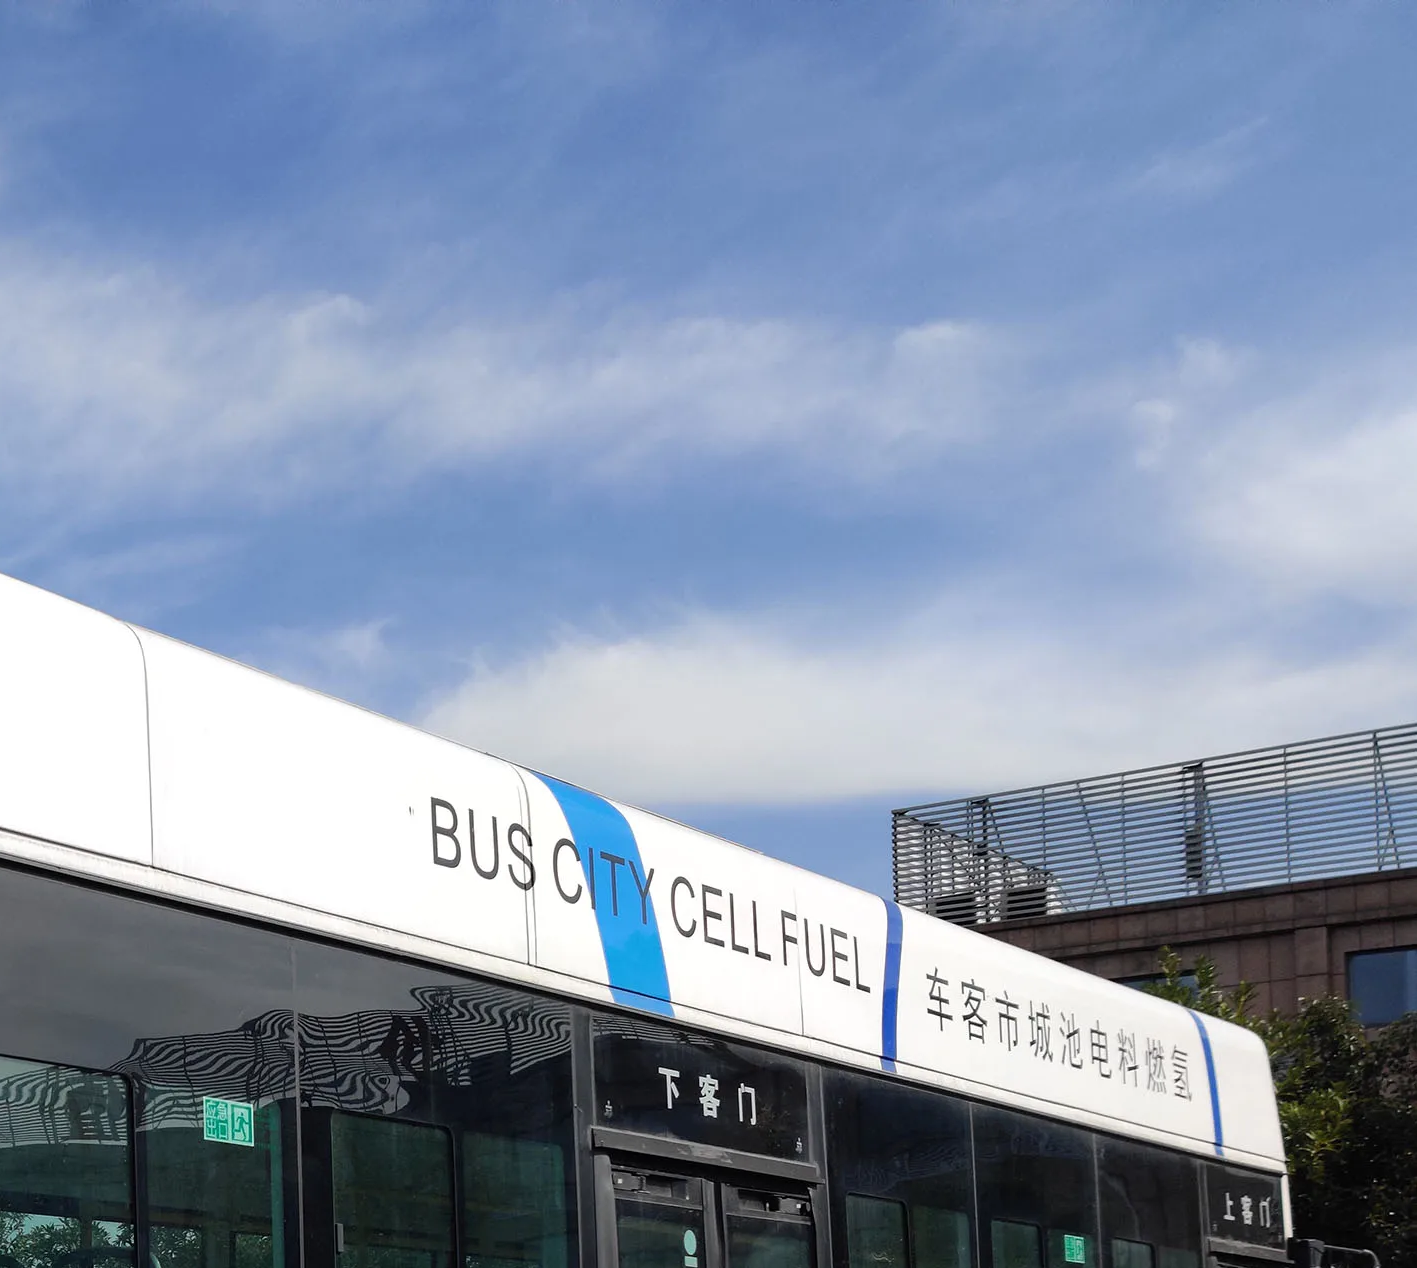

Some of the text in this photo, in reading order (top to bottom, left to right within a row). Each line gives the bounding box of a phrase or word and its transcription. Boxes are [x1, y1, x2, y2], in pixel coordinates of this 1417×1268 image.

[431, 796, 871, 994] BUS CITY CELL FUEL
[657, 1066, 757, 1126] 下客门
[1223, 1192, 1272, 1228] 上客门
